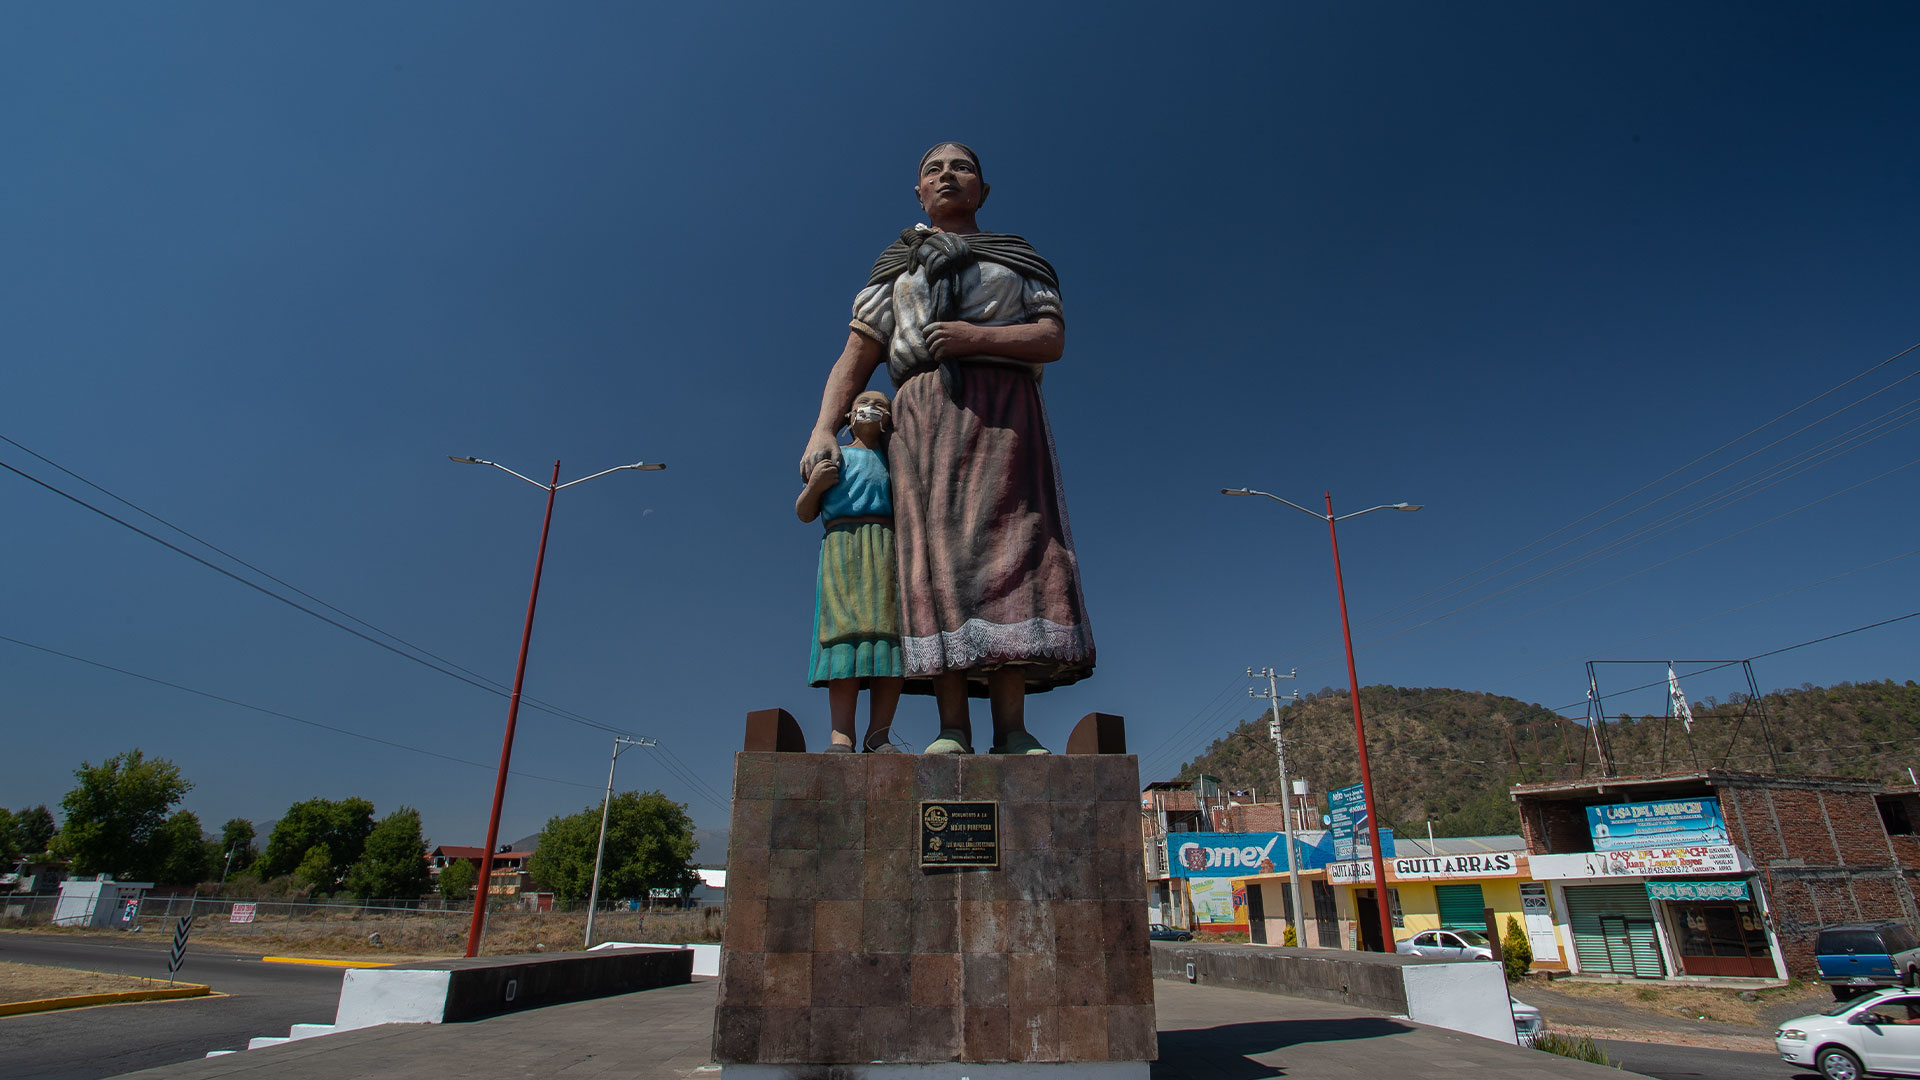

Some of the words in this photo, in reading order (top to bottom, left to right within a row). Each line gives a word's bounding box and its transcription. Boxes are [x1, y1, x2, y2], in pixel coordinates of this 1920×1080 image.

[1607, 806, 1631, 819] CASA
[1632, 805, 1653, 818] DEL
[1653, 802, 1702, 816] MARIACHI
[1179, 835, 1279, 869] Comex
[1610, 850, 1635, 861] CASA
[1638, 850, 1659, 859] DEL
[1661, 847, 1708, 859] MARIACHI
[1331, 862, 1371, 878] GUITARRAS
[1396, 854, 1511, 874] GUITARRAS
[1624, 859, 1645, 869] Juan
